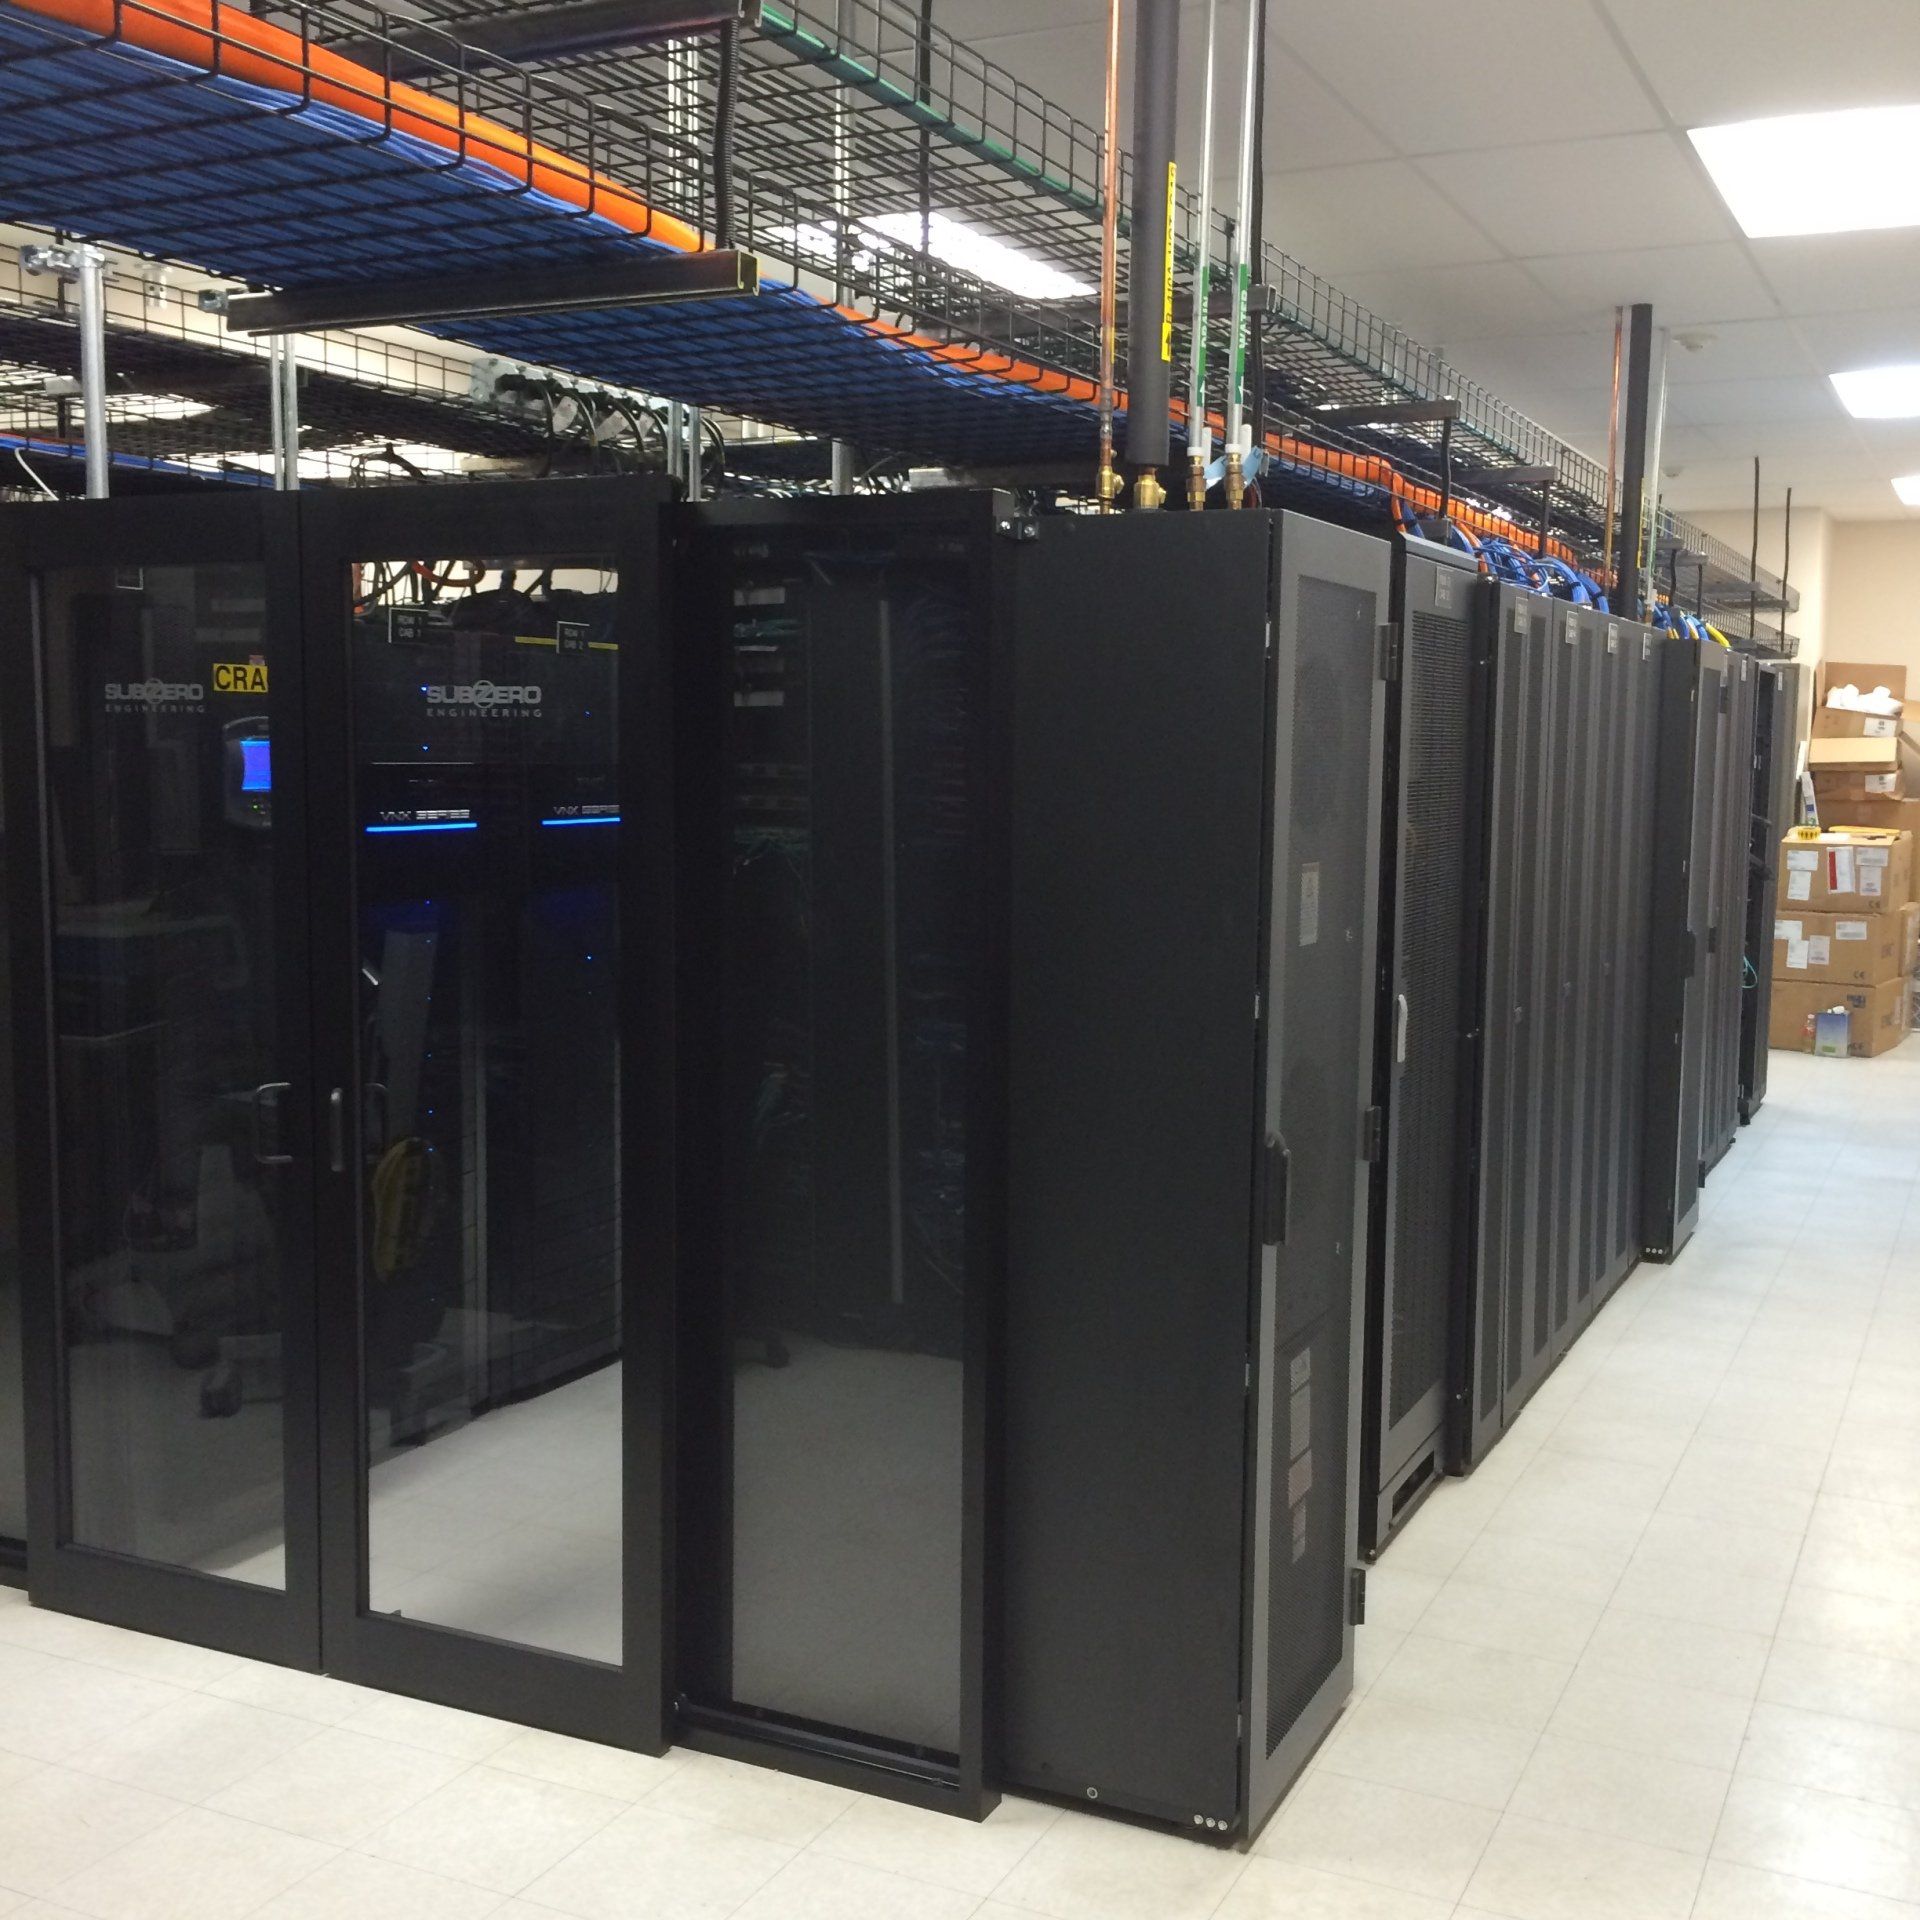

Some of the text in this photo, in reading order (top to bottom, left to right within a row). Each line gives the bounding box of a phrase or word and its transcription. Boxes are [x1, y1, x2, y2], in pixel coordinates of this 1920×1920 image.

[105, 679, 204, 704] SUBZERO
[426, 680, 542, 707] SUBZERO
[105, 704, 205, 713] ENGINEERING
[426, 708, 542, 718] ENGINEERING
